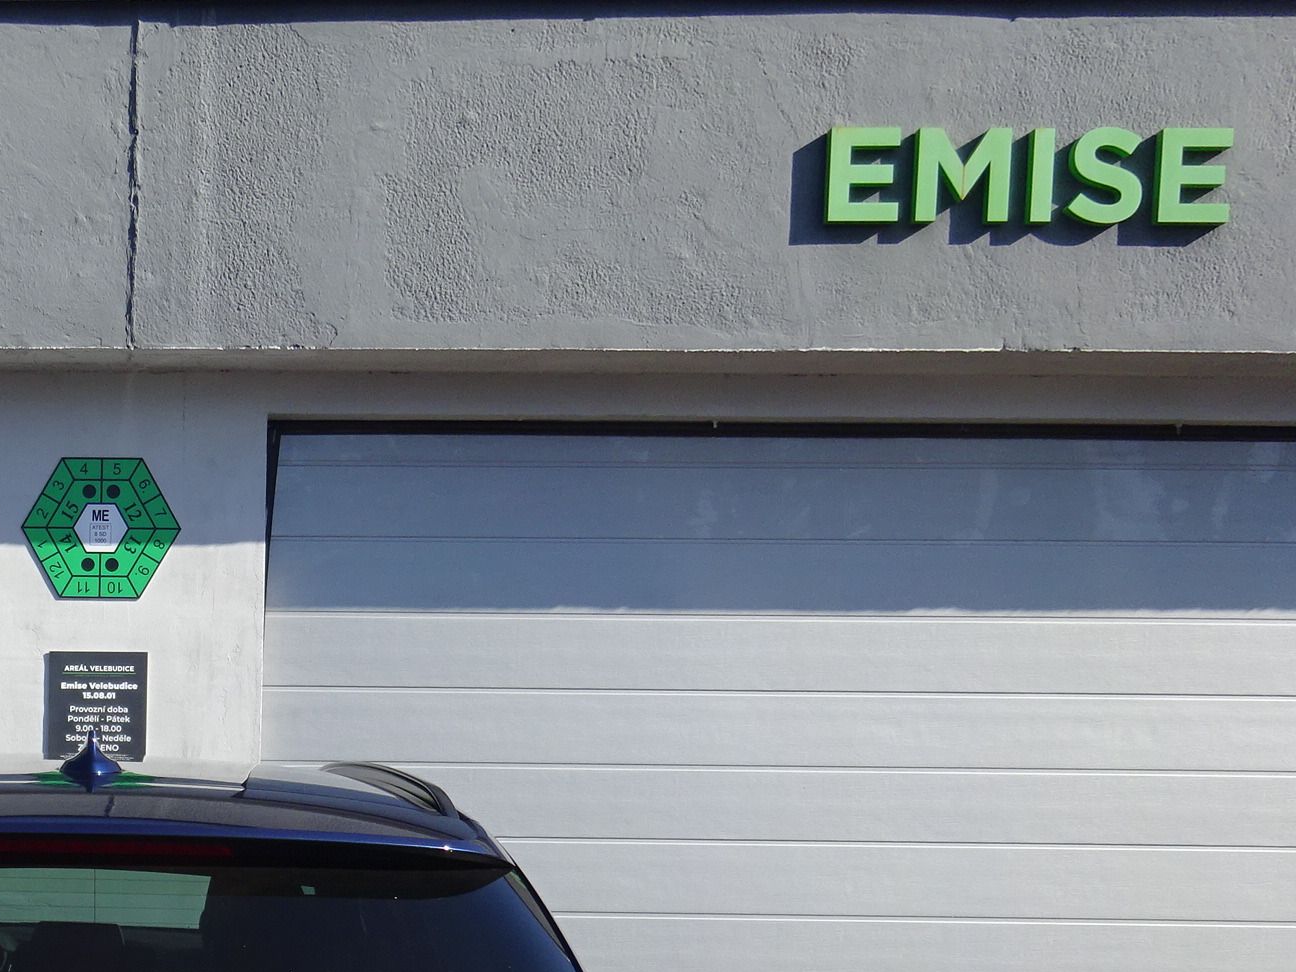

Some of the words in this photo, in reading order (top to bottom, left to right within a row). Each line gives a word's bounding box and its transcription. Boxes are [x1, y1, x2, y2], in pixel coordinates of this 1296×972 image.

[825, 126, 1234, 226] EMISE
[80, 464, 88, 475] 4
[113, 463, 121, 475] 5
[53, 480, 65, 491] 3
[36, 508, 49, 520] 2
[61, 500, 80, 521] 15
[92, 510, 109, 522] ME
[124, 503, 142, 521] 12
[156, 508, 167, 517] 7
[59, 533, 77, 553] 14
[124, 536, 142, 554] 13
[152, 539, 166, 550] 8
[50, 562, 64, 578] 12
[77, 581, 90, 593] 11
[107, 581, 121, 593] 10
[64, 664, 89, 672] AREÁL
[60, 681, 88, 690] Emise
[89, 681, 138, 690] Velebudice
[82, 691, 116, 700] 15.08.01
[69, 705, 106, 713] Provozní
[107, 705, 129, 713] doba
[67, 715, 100, 723] Pondělí
[106, 715, 131, 723] Pátek
[100, 724, 122, 732] 18.00
[102, 734, 132, 742] Neděle
